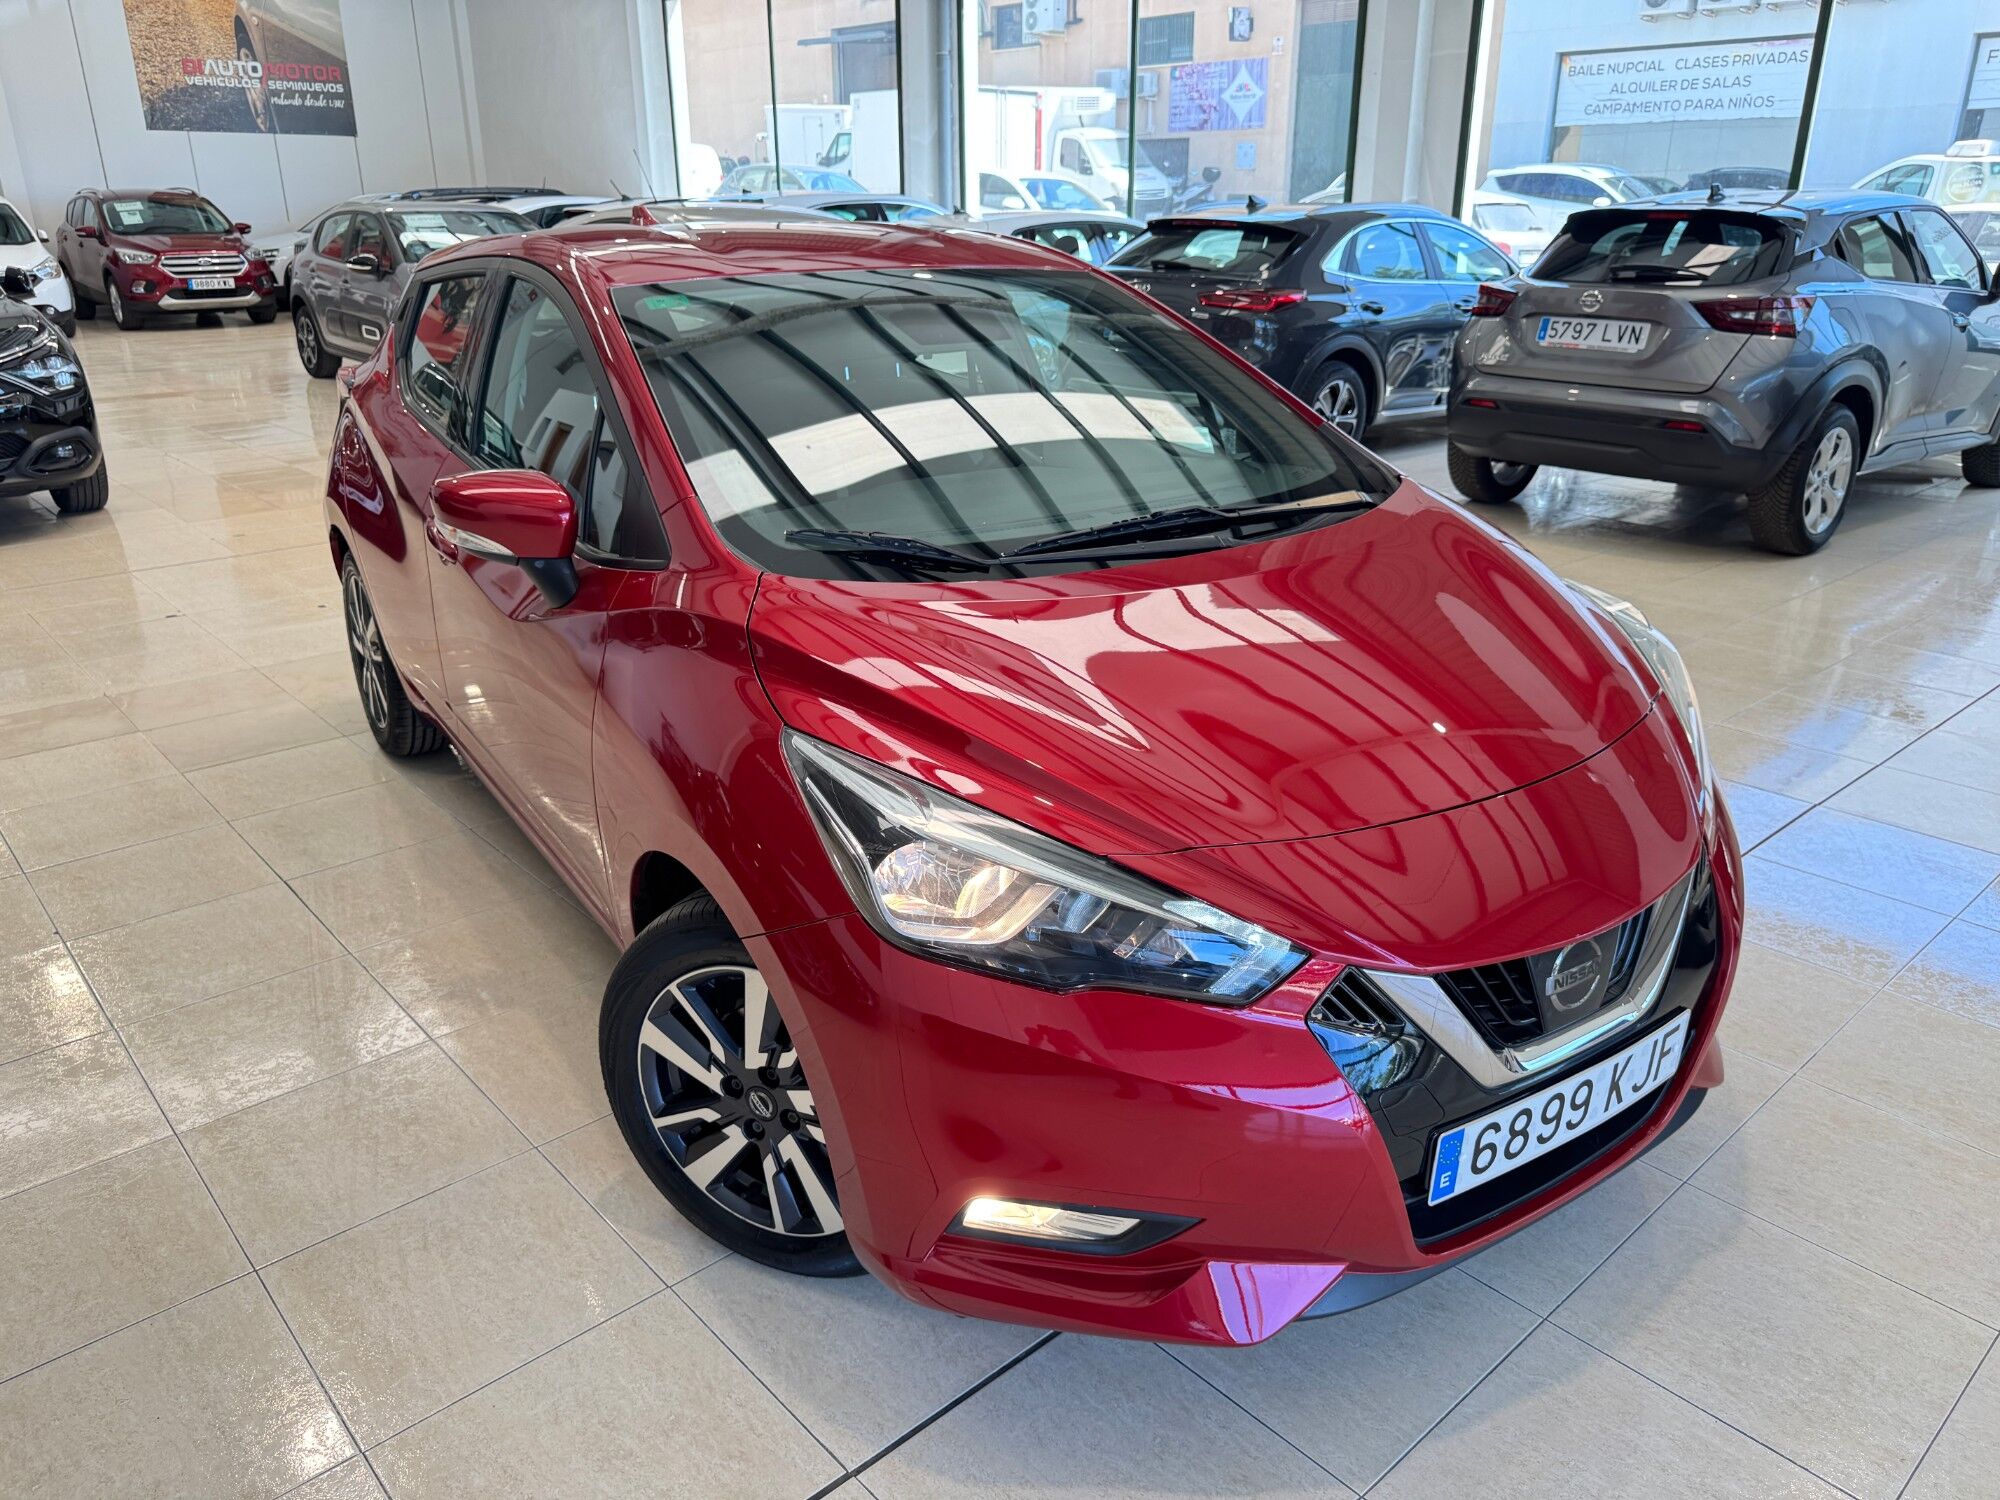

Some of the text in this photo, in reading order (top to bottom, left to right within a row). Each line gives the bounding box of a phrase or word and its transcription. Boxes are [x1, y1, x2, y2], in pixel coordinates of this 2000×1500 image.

[1568, 50, 1808, 77] BAILE NUPCIAL CLASES PRIVADAS
[184, 76, 344, 93] VEHICULOS SEMINUEVOS
[1610, 75, 1752, 95] ALQUILER DE SALAS
[304, 93, 328, 107] desde
[1584, 94, 1775, 116] CAMPAMENTO PARA NIÑOS
[194, 280, 215, 289] 9880
[1549, 320, 1644, 345] 5797 LVN
[1440, 1024, 1680, 1187] E 6899 KJF
